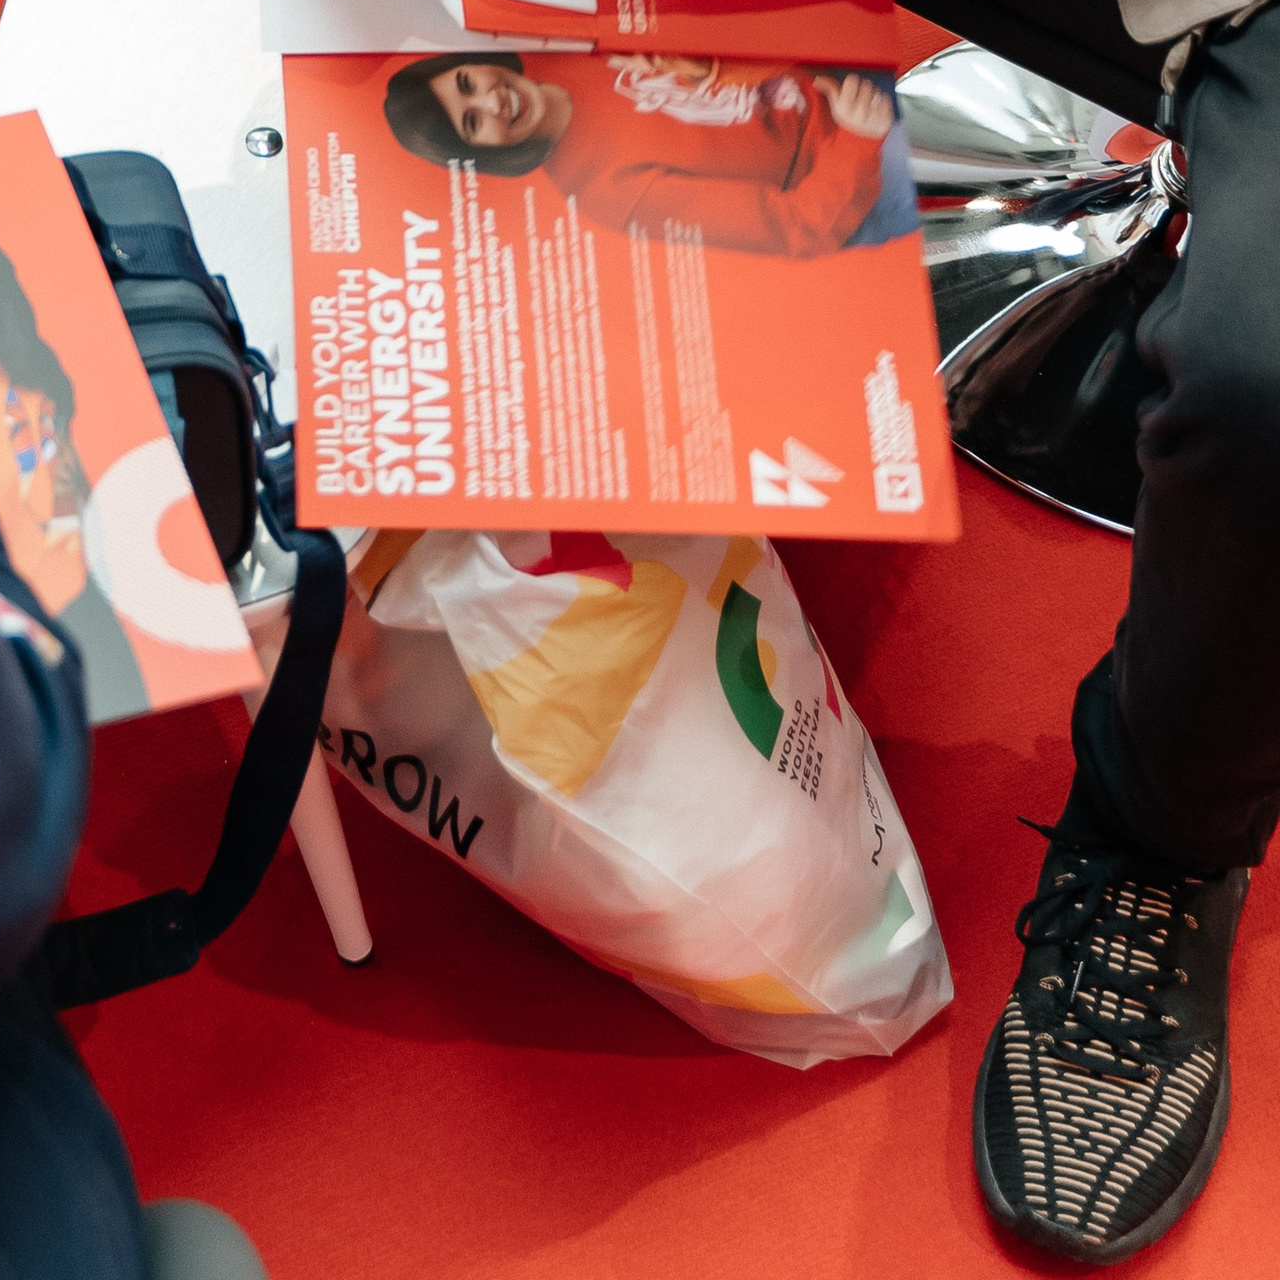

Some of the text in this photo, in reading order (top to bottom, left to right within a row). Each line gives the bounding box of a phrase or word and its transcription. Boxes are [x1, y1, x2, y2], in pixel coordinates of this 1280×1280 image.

[309, 294, 346, 495] BUILD YOUR
[337, 268, 373, 495] CAREER WITH
[366, 266, 416, 497] SYNERGY
[401, 208, 456, 496] UNIVERSITY
[777, 699, 803, 774] WORLD
[790, 710, 812, 781] YOUTH
[800, 696, 821, 793] FESTIVAL
[809, 752, 824, 802] 2024
